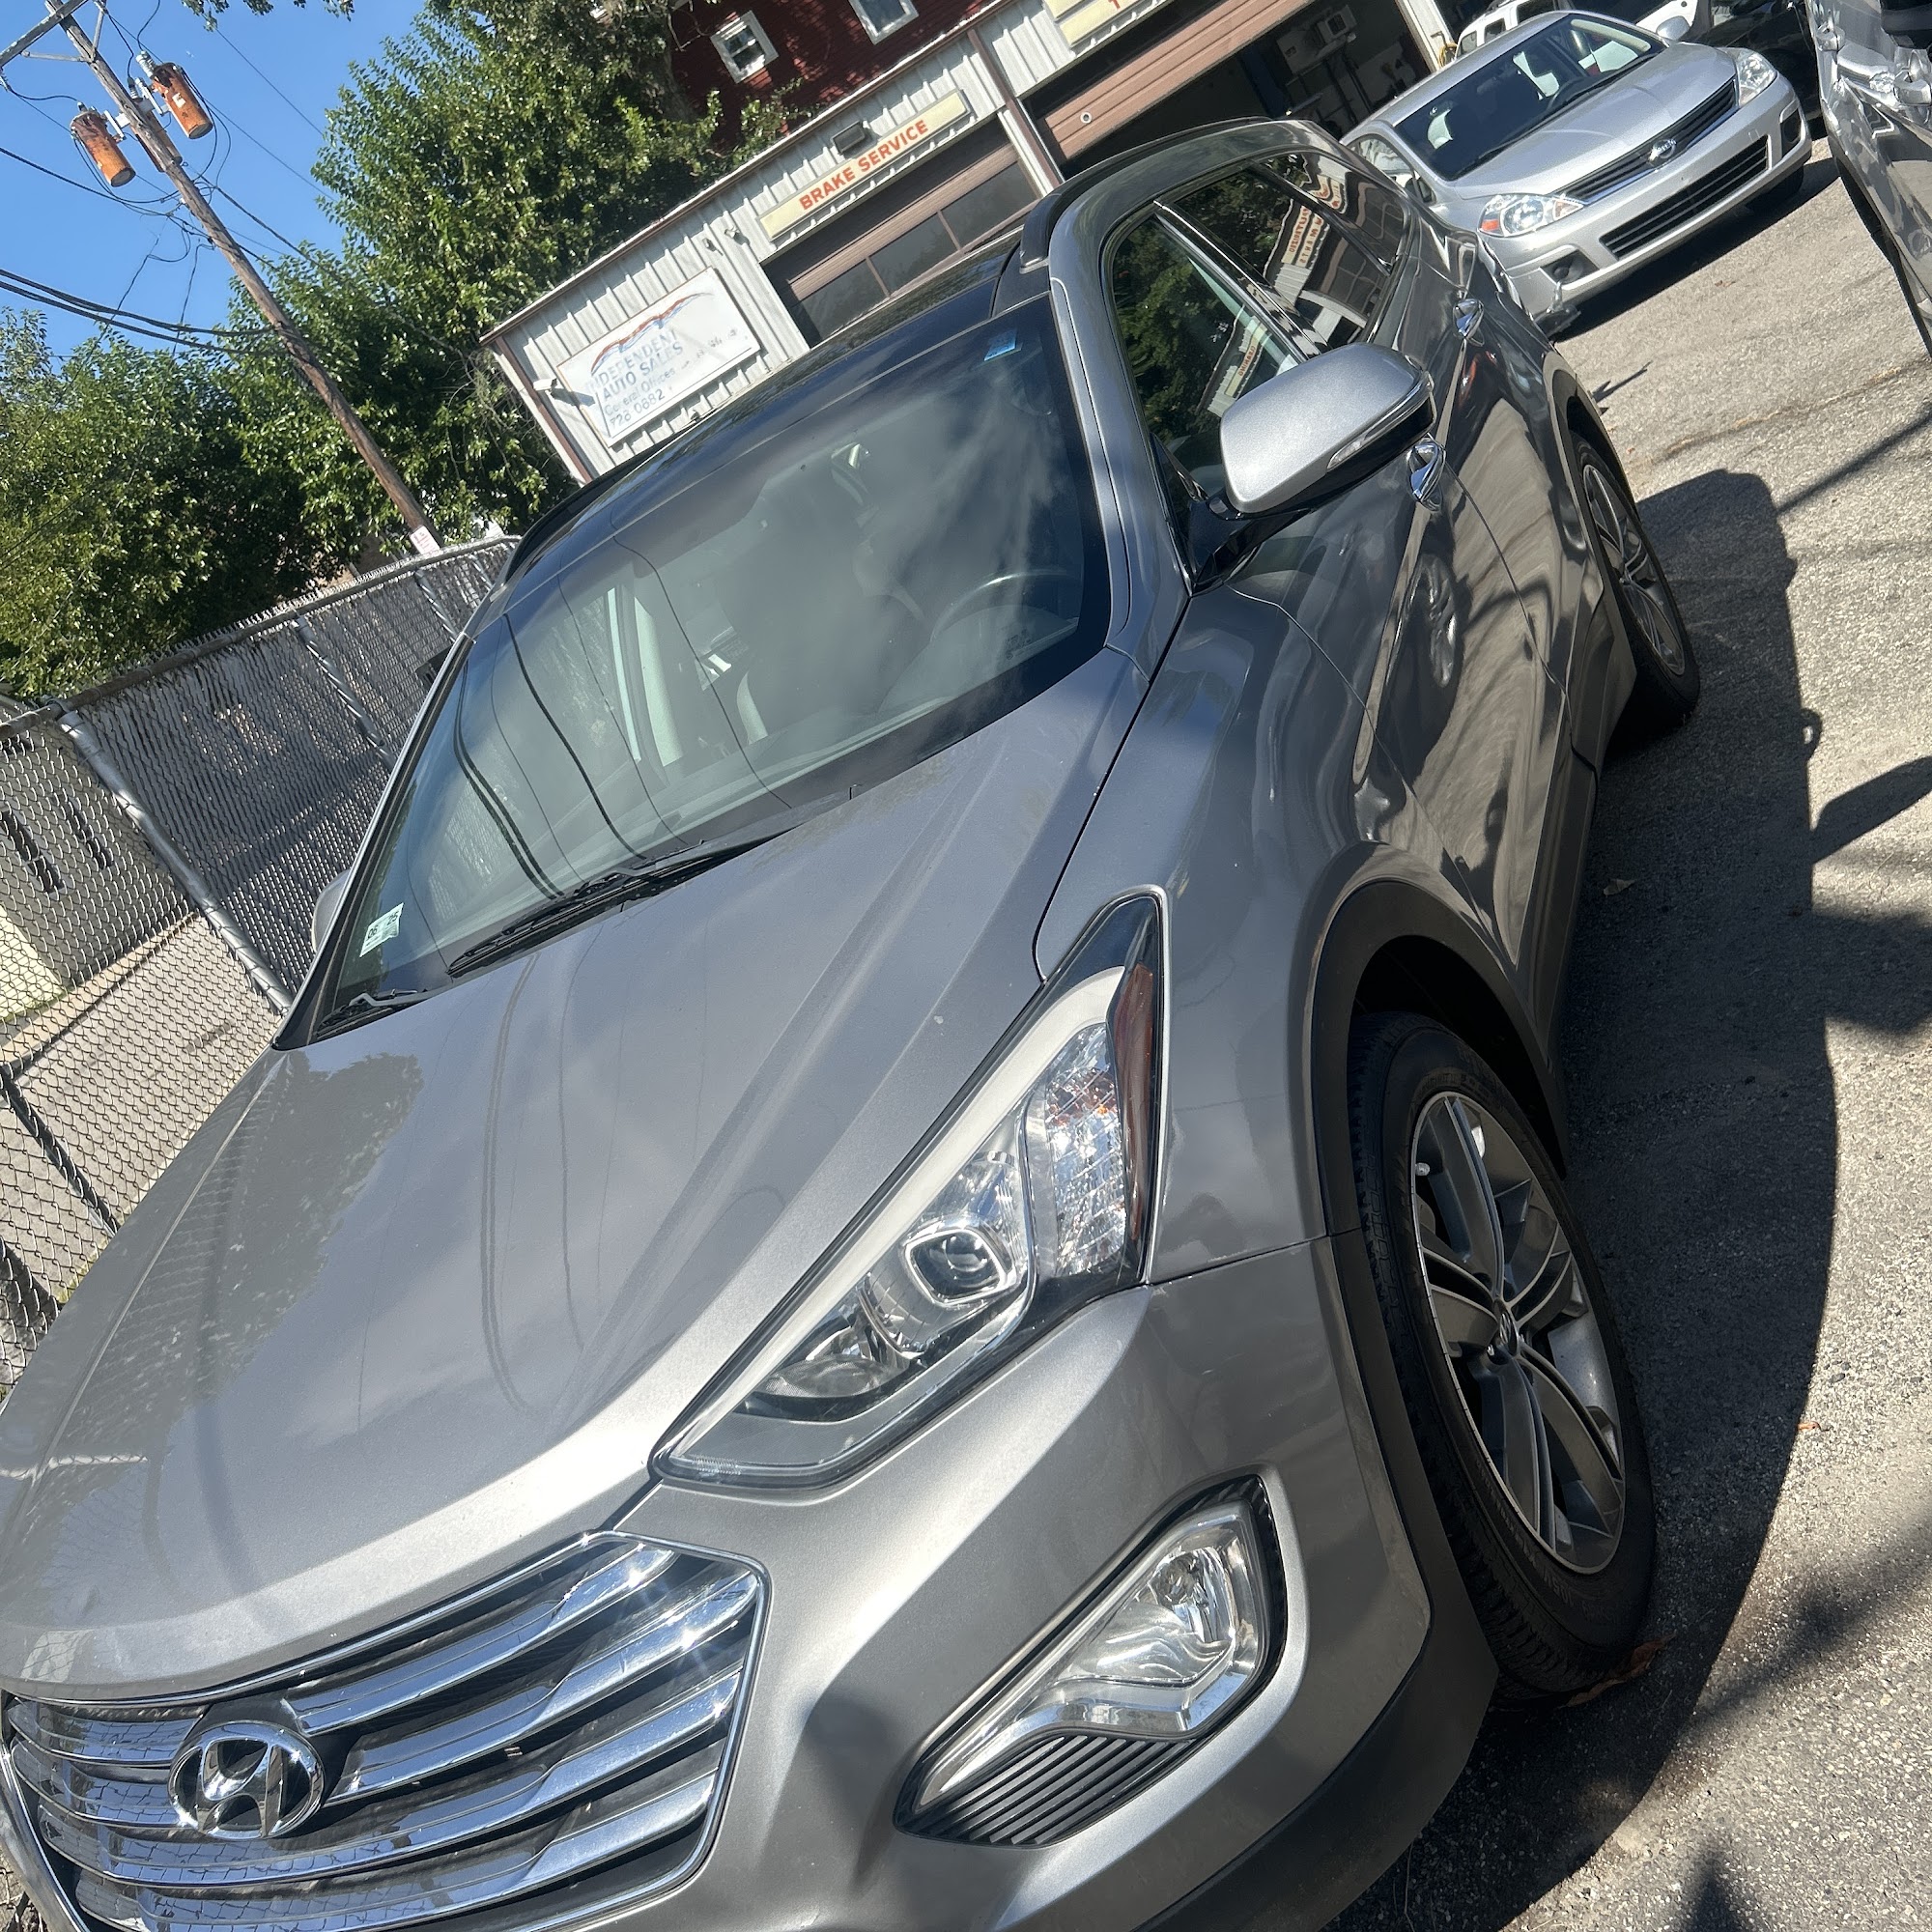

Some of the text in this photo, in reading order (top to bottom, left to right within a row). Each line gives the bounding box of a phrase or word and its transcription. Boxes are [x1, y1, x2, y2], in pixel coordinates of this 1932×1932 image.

[799, 119, 929, 211] BRAKE SERVICE
[603, 371, 637, 401] AUTO
[639, 341, 684, 377] SALES
